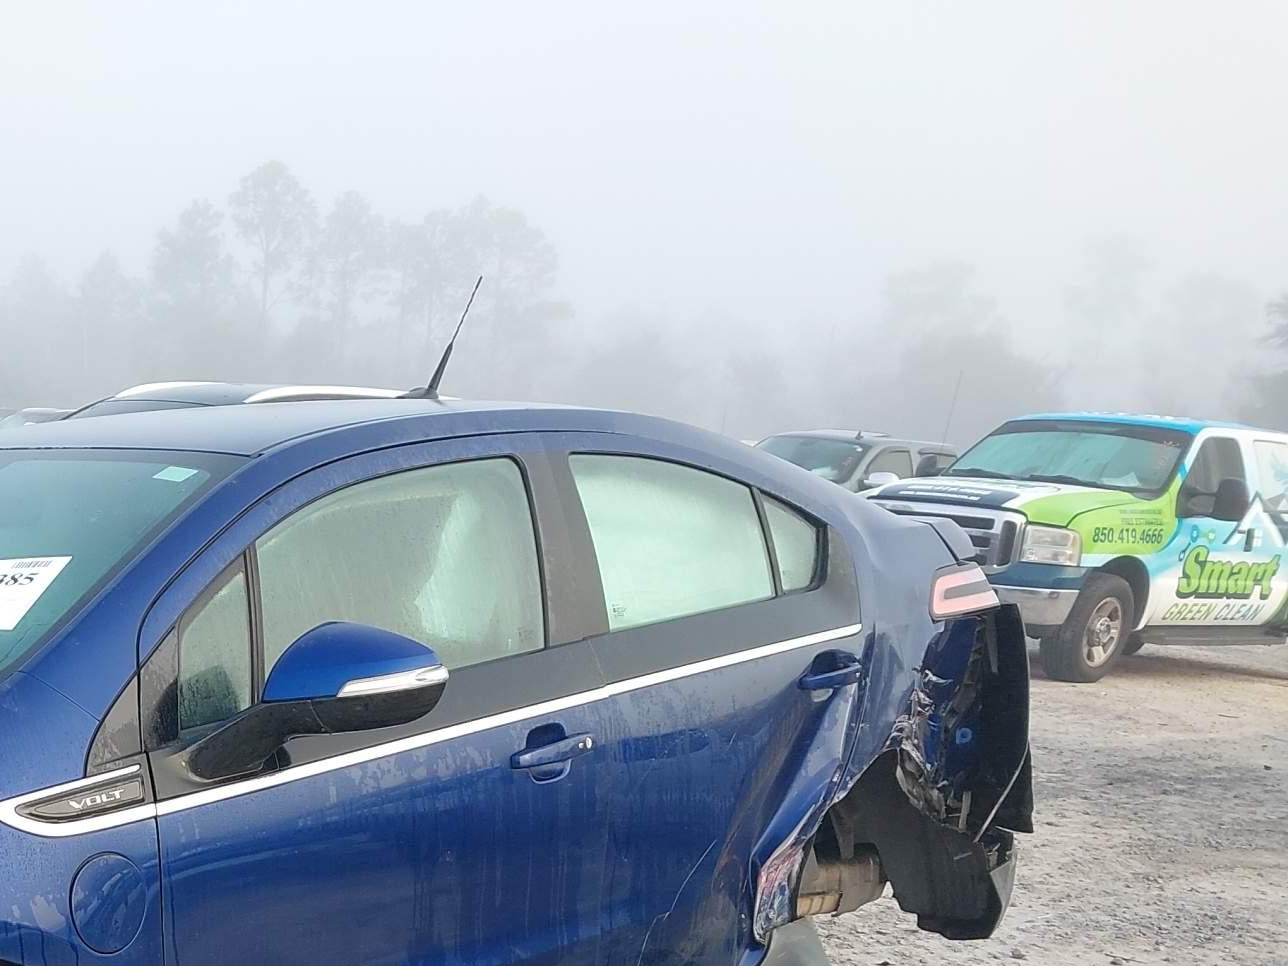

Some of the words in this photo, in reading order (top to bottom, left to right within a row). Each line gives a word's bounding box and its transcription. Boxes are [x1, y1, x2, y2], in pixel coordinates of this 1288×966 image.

[1092, 526, 1164, 545] 850.419.4666
[1175, 545, 1282, 600] Smart
[1161, 603, 1217, 621] GREEN
[1214, 603, 1266, 621] CLEAN
[68, 789, 125, 809] VOLT
